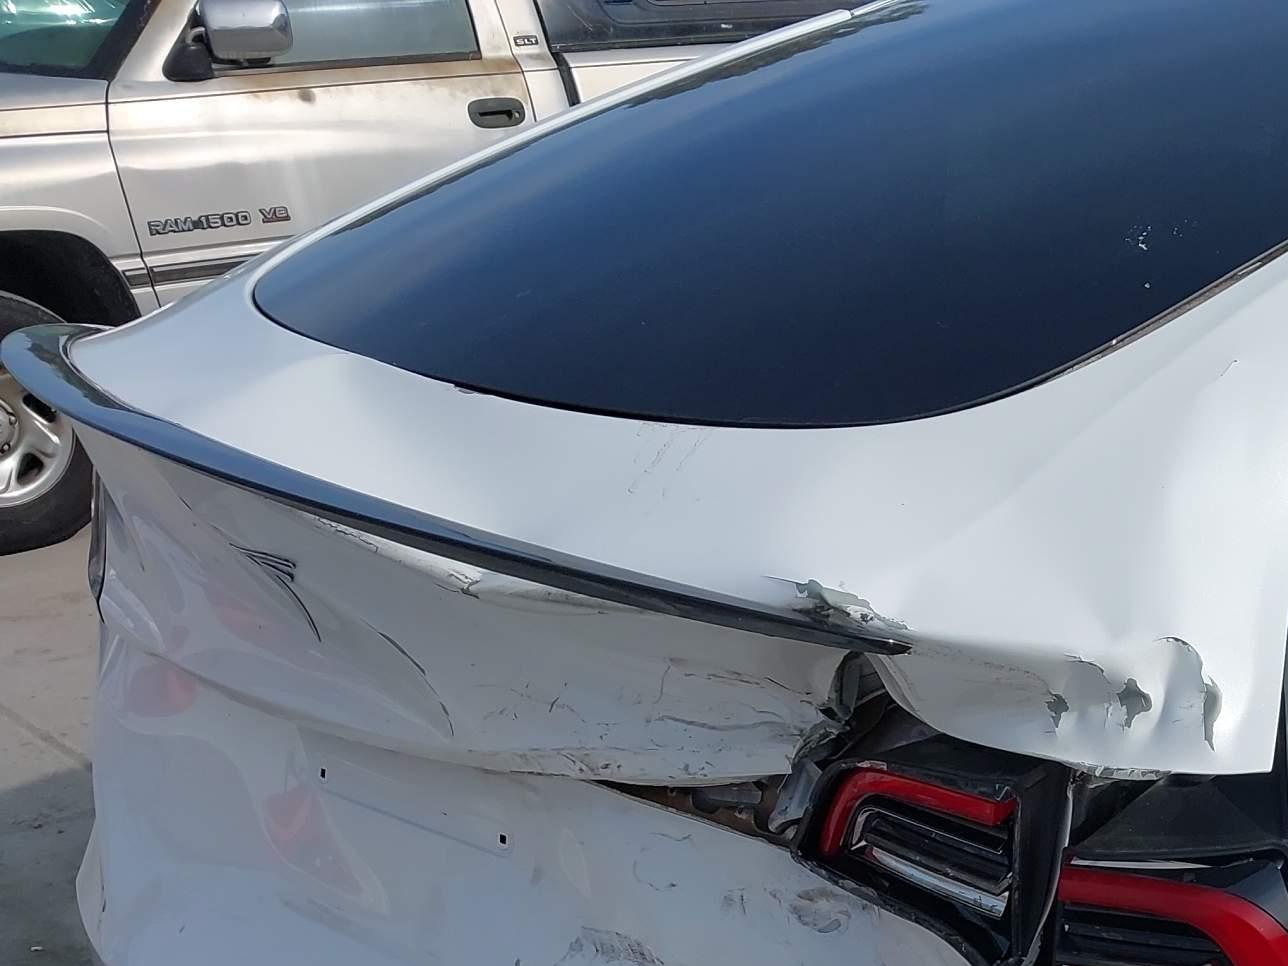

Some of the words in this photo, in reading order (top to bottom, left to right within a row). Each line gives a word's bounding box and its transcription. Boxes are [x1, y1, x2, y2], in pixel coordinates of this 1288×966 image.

[516, 37, 537, 45] SLT
[148, 216, 193, 236] RAM
[198, 211, 251, 230] 1500
